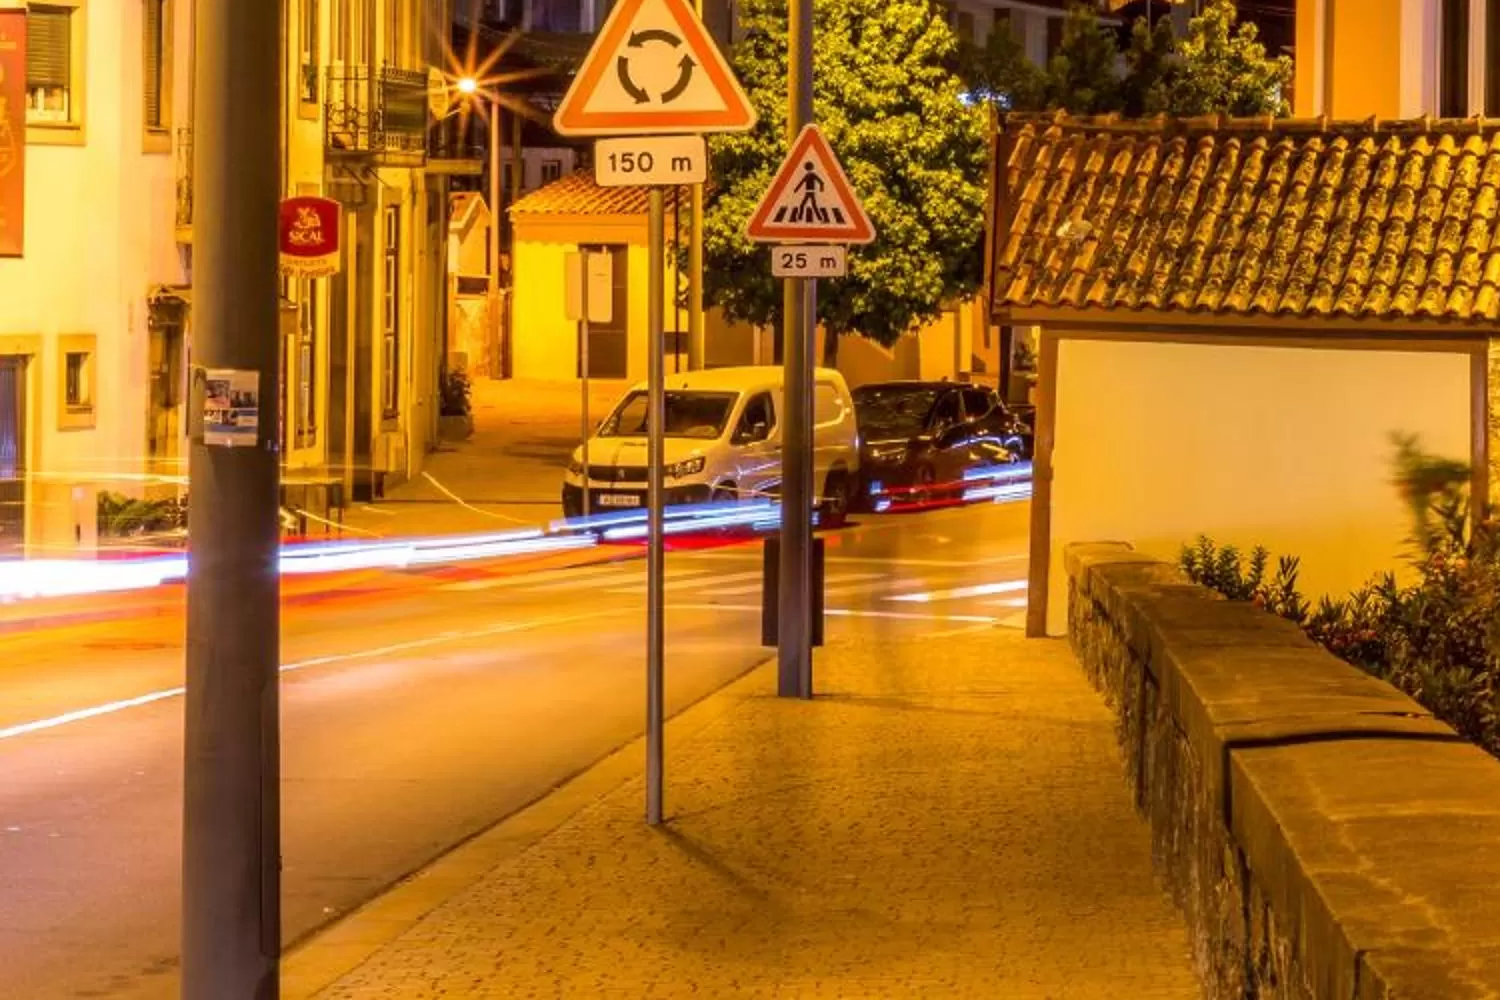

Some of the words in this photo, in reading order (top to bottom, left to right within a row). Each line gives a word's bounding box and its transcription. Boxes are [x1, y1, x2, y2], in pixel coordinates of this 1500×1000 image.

[608, 152, 653, 172] 150
[671, 156, 692, 172] m
[781, 252, 807, 268] 25
[820, 256, 836, 268] m
